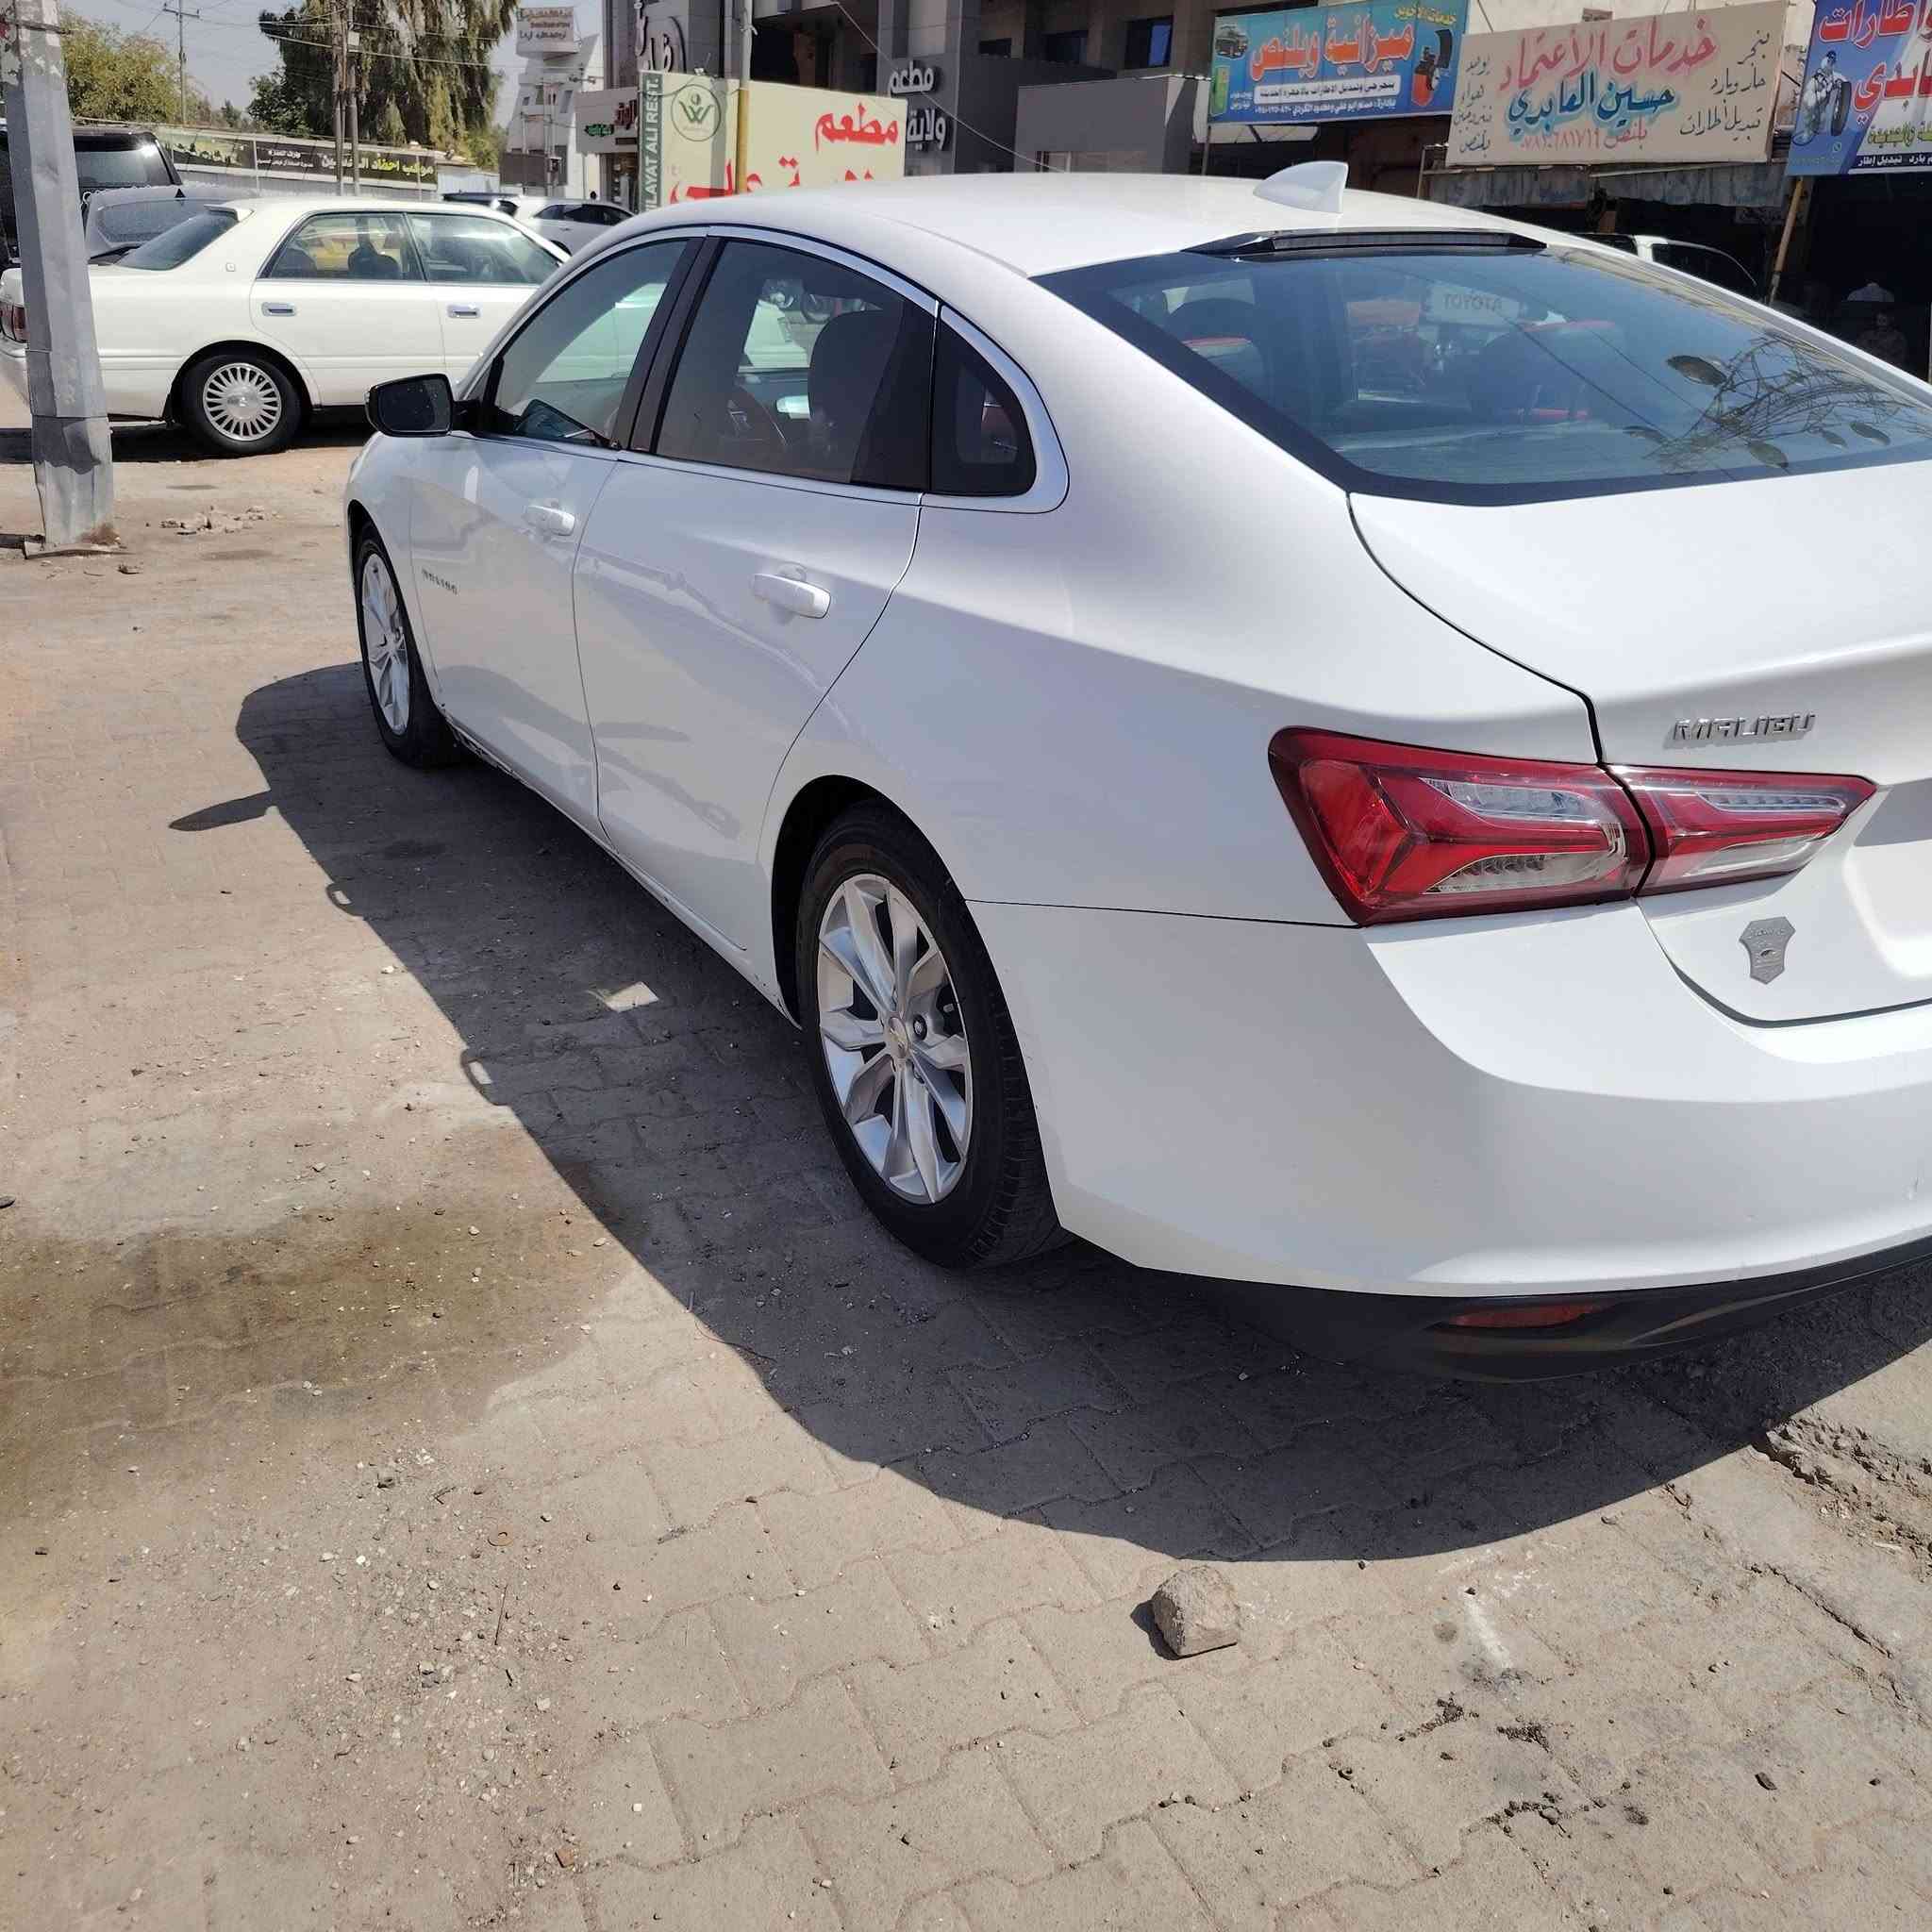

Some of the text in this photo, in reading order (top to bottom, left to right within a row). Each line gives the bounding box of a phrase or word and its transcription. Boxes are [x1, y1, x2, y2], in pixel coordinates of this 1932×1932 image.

[1323, 13, 1415, 75] ميزانية
[1613, 15, 1718, 74] خدمات
[888, 60, 934, 95] مطعم
[1508, 71, 1675, 134] حسين العابدي
[645, 78, 658, 210] ILAYAT ALI REST.
[815, 102, 899, 155] مطعم
[1673, 714, 1816, 741] MALIBU
